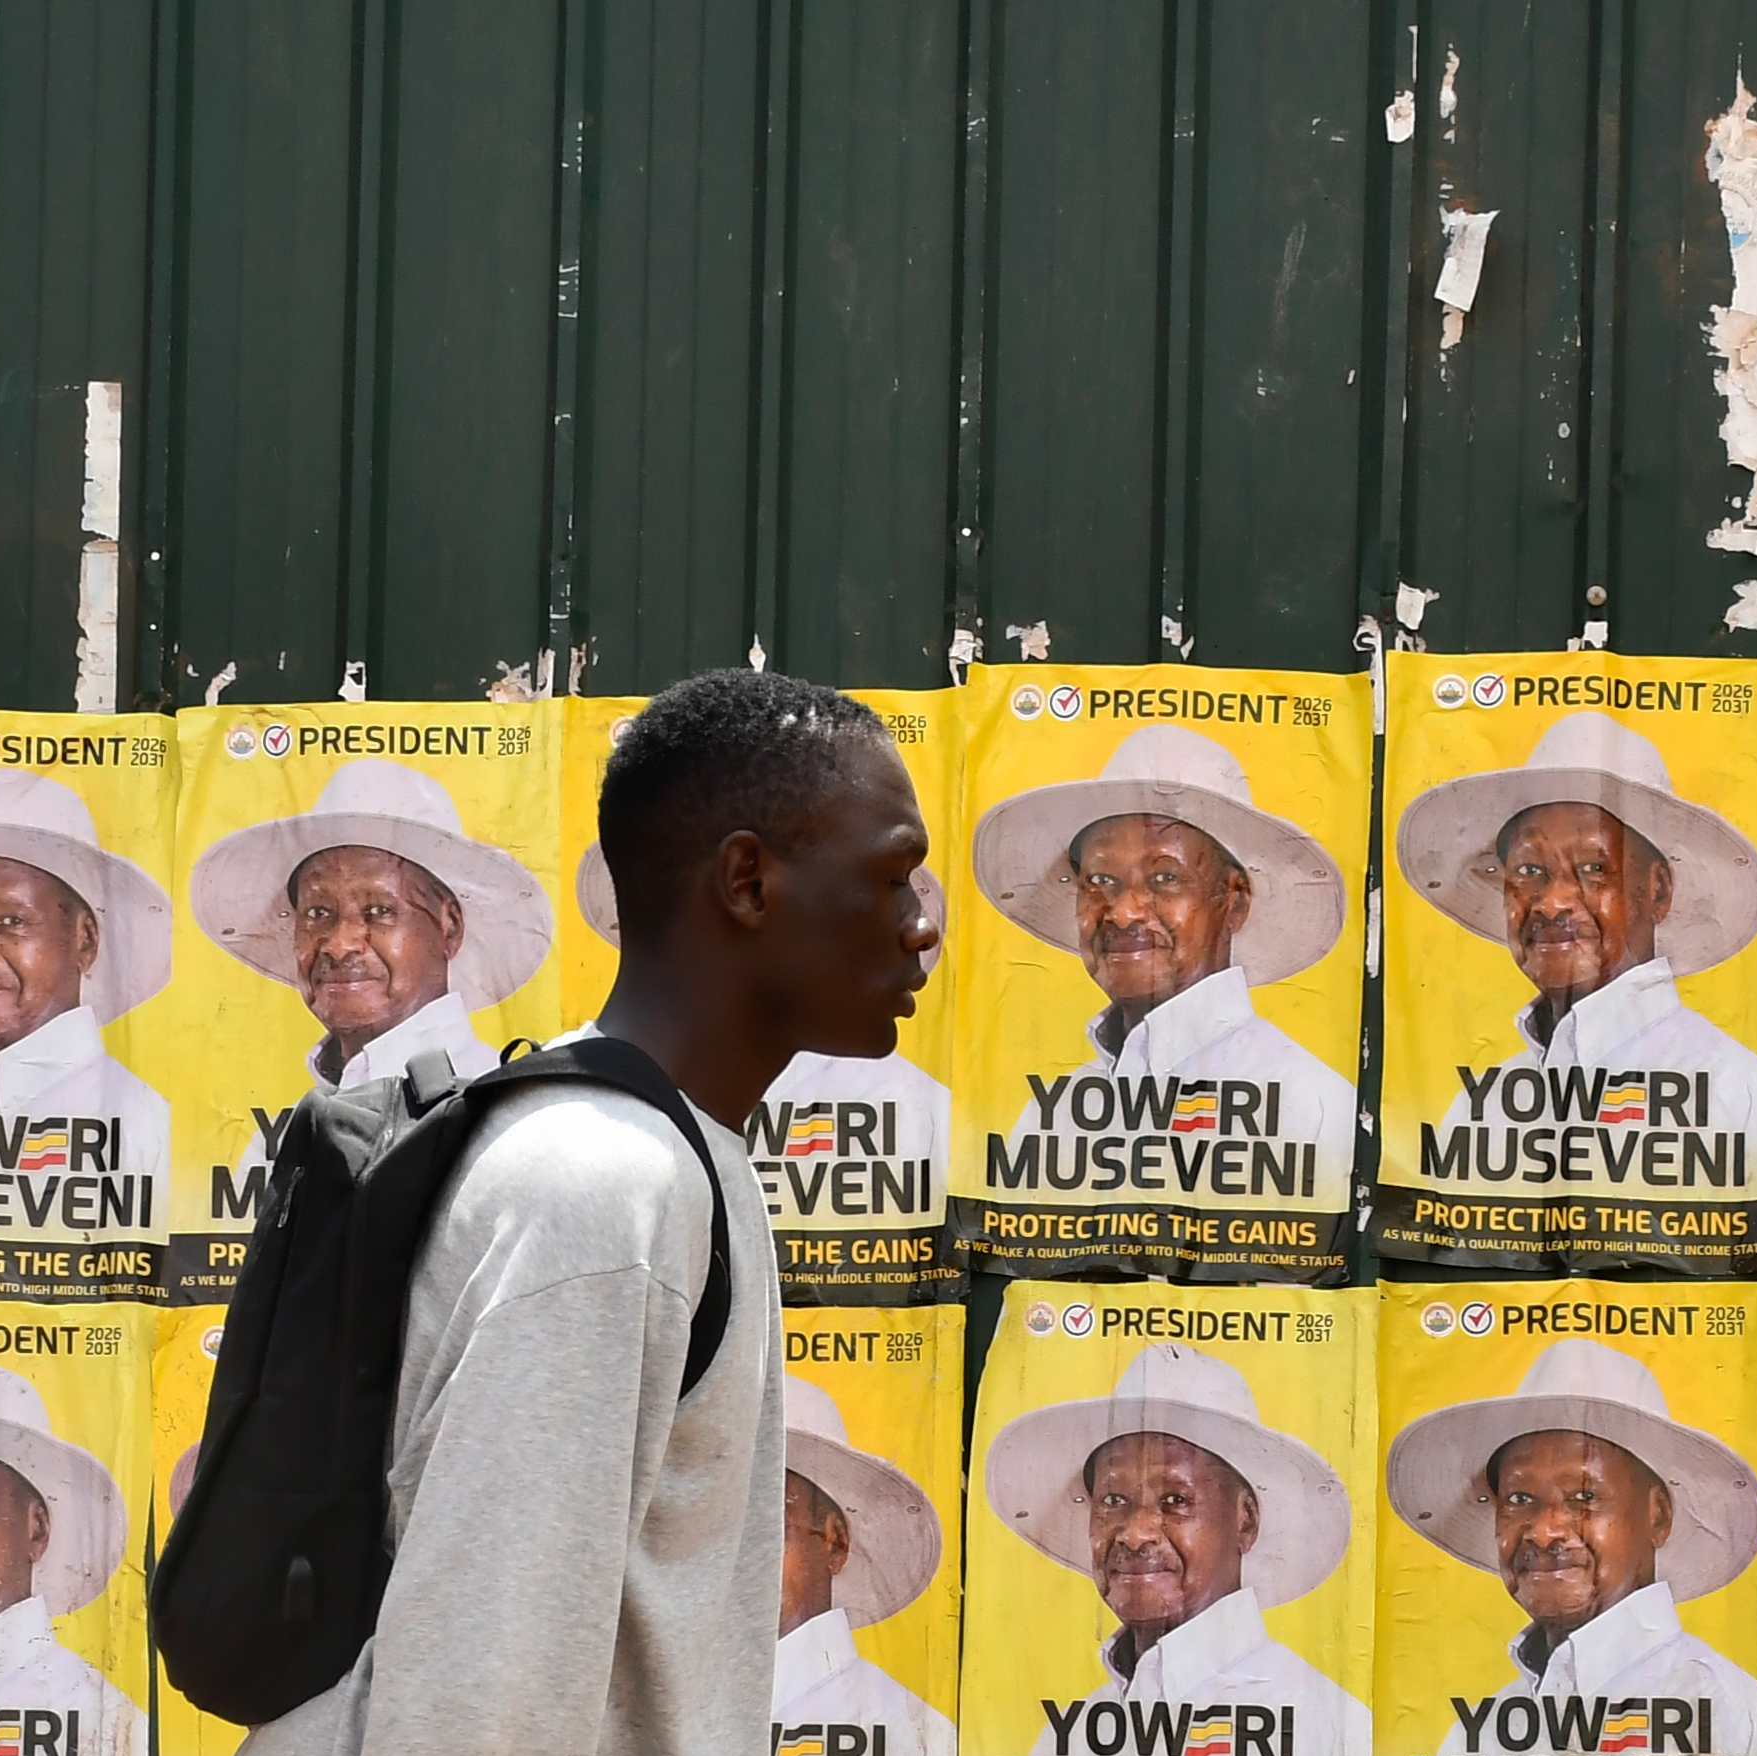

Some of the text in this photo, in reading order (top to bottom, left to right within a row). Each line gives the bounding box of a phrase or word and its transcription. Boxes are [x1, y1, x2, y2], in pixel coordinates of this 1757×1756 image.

[1090, 689, 1287, 723] PRESIDENT
[1515, 676, 1706, 711] PRESIDENT
[1712, 699, 1749, 713] 2031
[1713, 684, 1752, 698] 2026
[300, 726, 491, 755] PRESIDENT
[987, 1133, 1315, 1197] MUSEVENI
[1421, 1123, 1744, 1186] MUSEVENI
[15, 1252, 68, 1276] THE
[79, 1252, 150, 1277] GAINS
[1103, 1308, 1290, 1341] PRESIDENT
[1297, 1314, 1333, 1327] 2026
[1503, 1303, 1699, 1335] PRESIDENT
[1296, 1329, 1330, 1342] 2031
